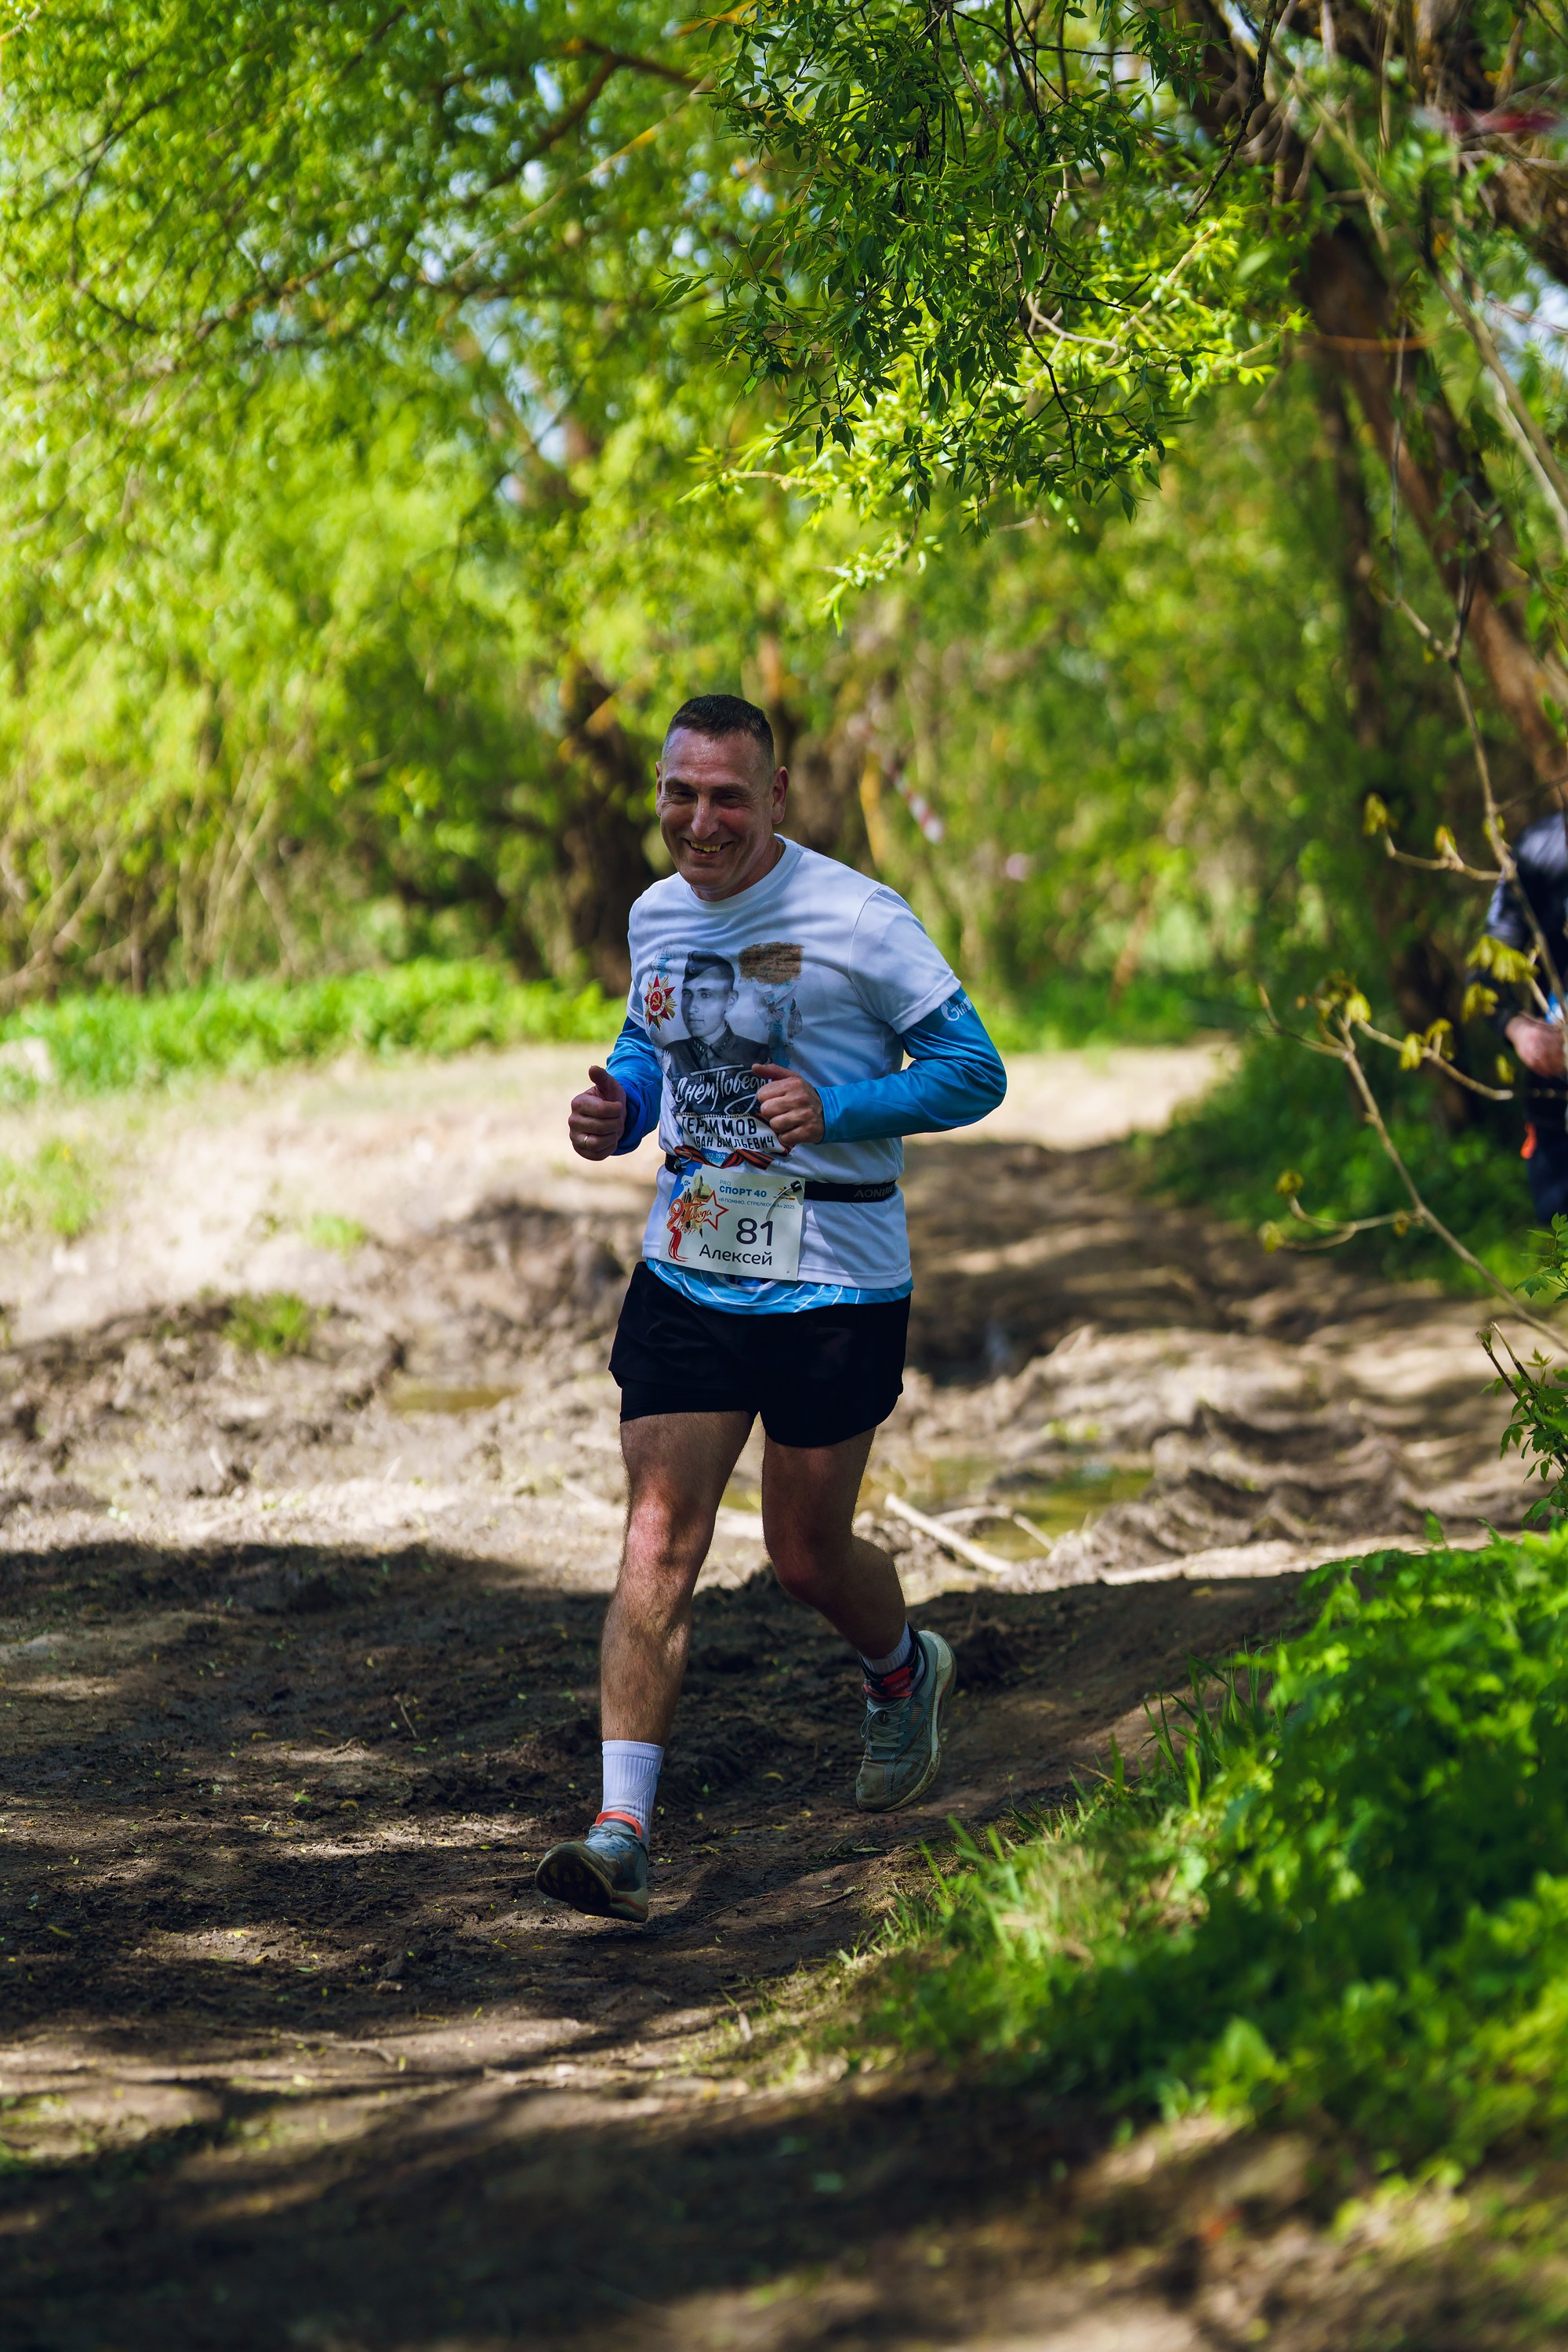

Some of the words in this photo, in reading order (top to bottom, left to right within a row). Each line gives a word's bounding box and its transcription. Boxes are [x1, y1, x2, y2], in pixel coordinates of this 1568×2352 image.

[719, 1185, 753, 1196] СПОРТ
[735, 1218, 774, 1247] 81
[699, 1243, 773, 1266] Алексей
